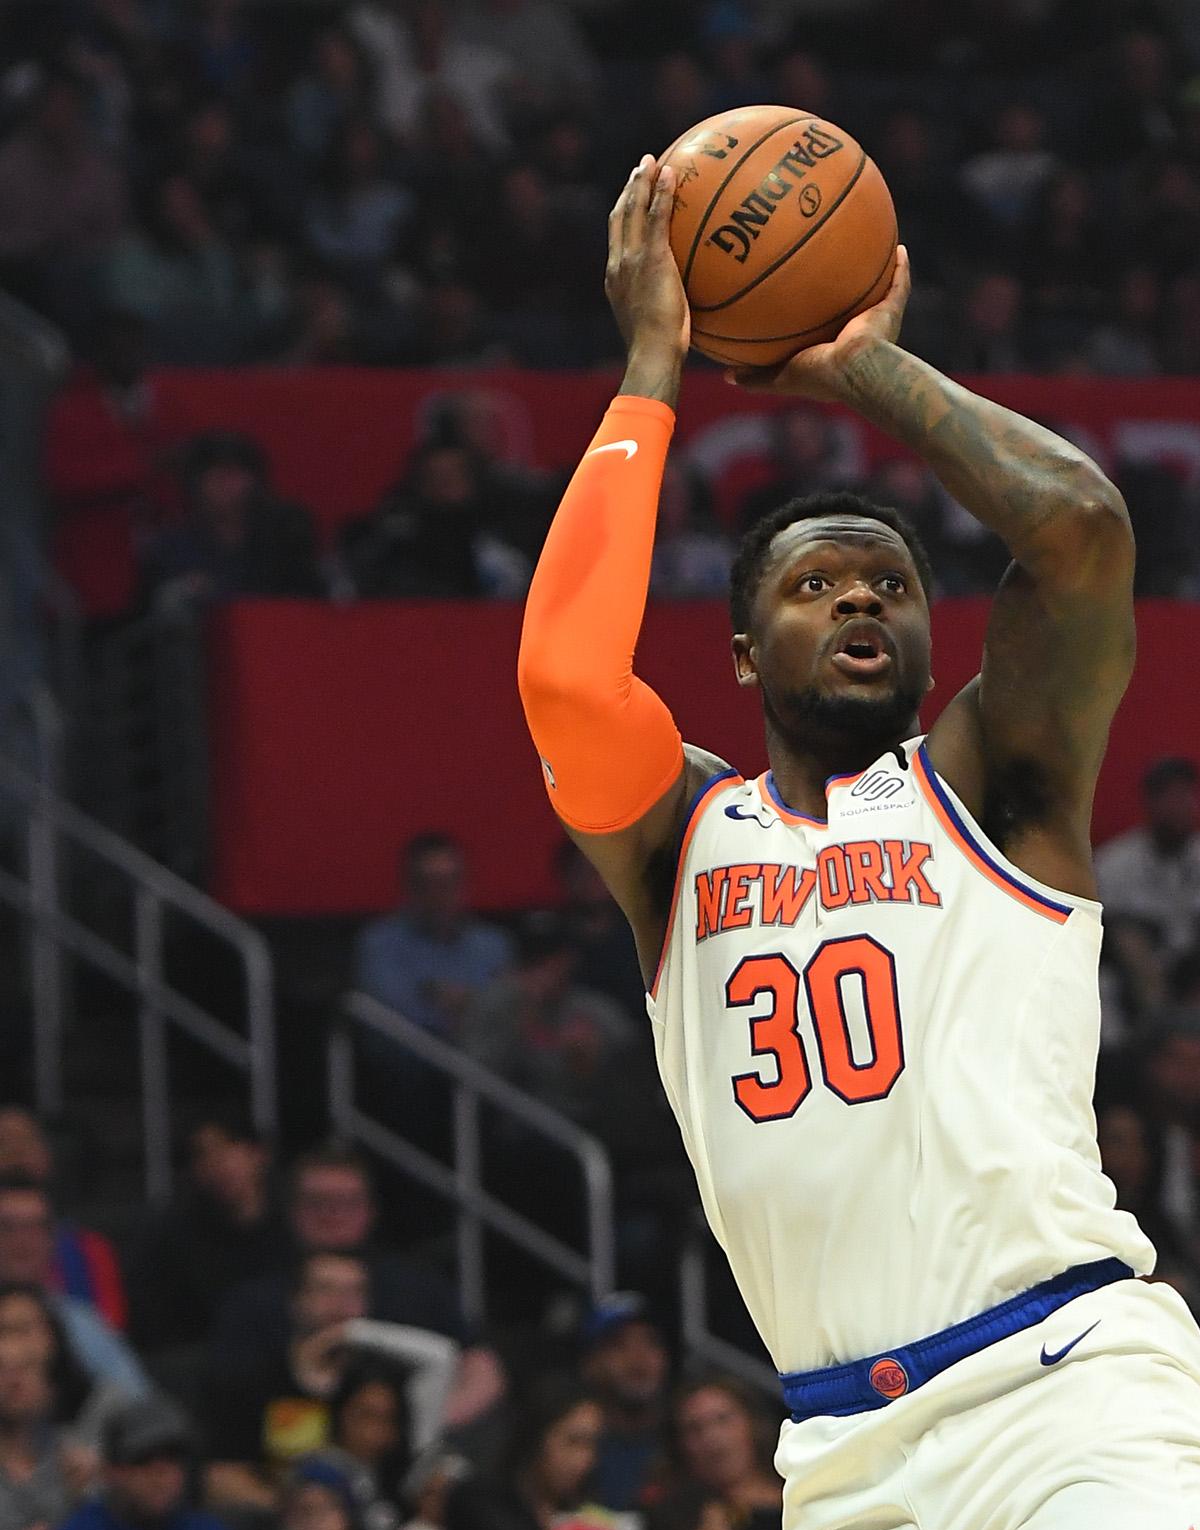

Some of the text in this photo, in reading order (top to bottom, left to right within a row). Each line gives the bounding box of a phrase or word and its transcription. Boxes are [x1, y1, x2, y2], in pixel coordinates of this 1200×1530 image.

[708, 123, 843, 264] SPALDING
[694, 839, 943, 945] NEW ORK
[725, 932, 906, 1125] 30
